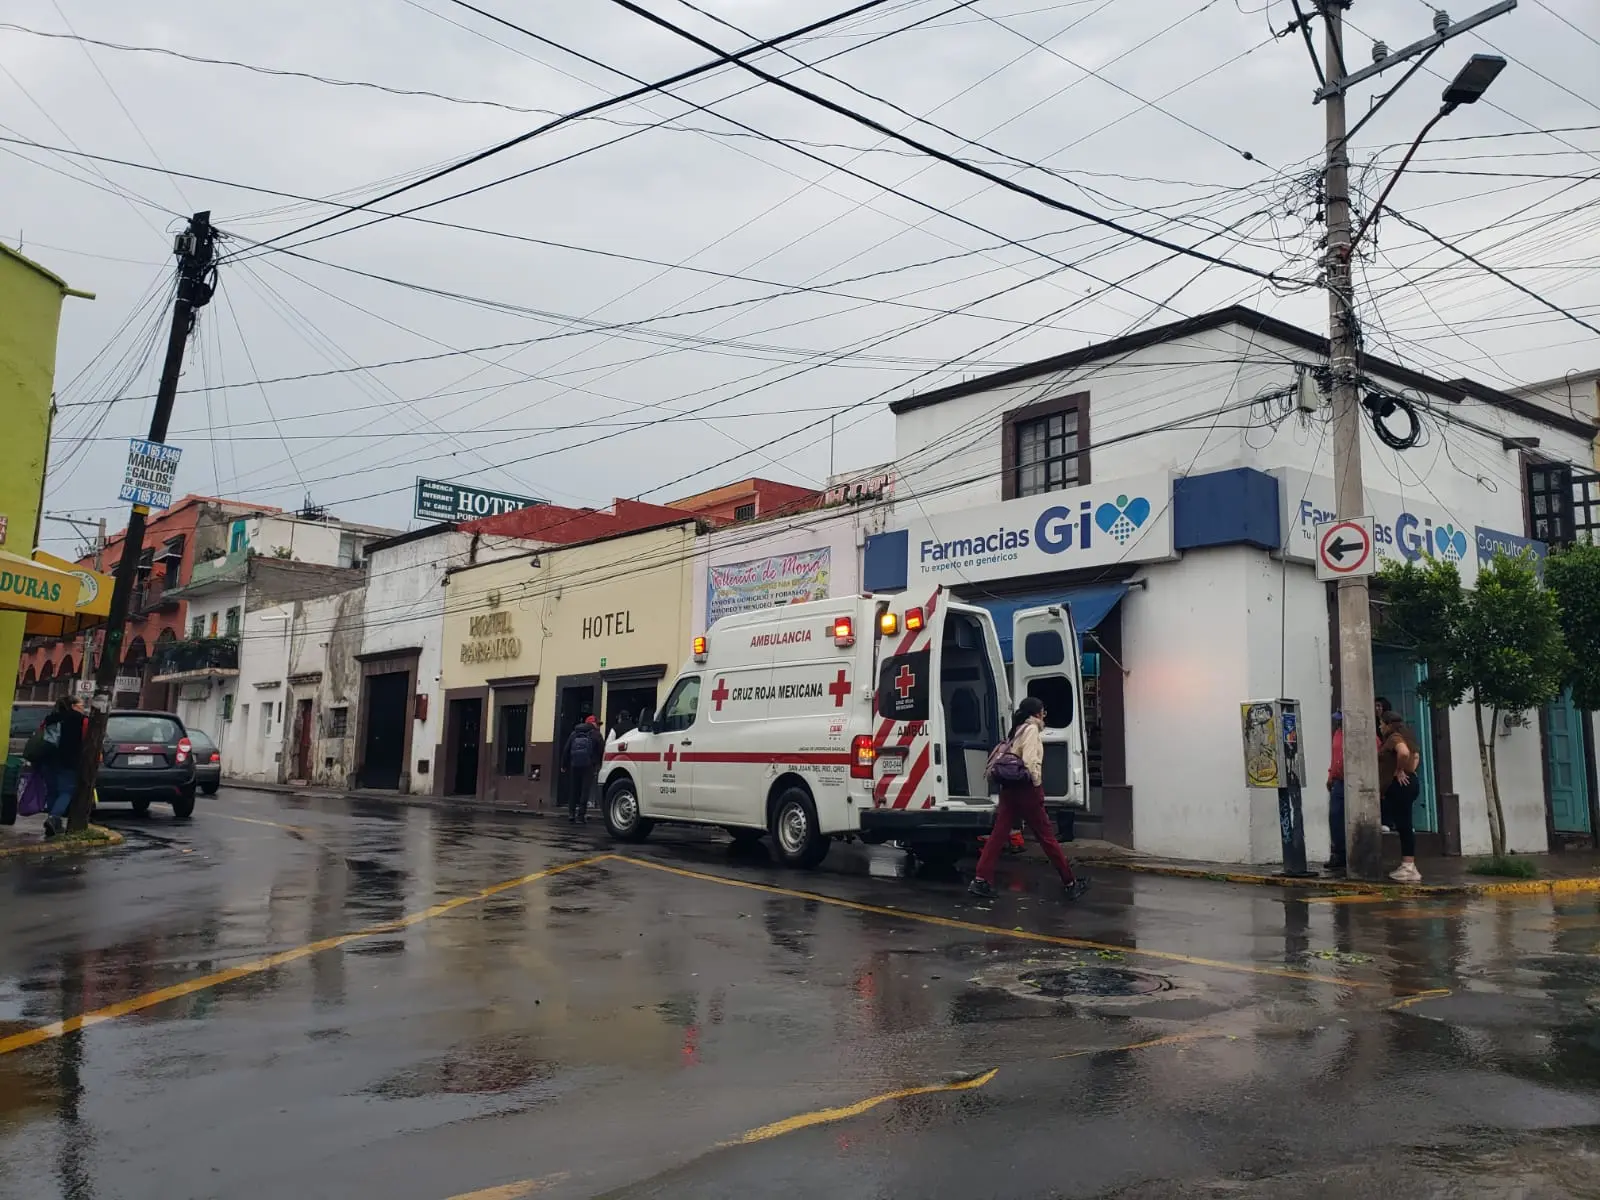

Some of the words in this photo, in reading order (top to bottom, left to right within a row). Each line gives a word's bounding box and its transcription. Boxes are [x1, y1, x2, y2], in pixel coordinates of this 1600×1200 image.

[130, 440, 145, 453] 427
[128, 453, 177, 475] MARIACHI
[125, 477, 134, 485] DE
[132, 467, 168, 485] GALLOS
[121, 485, 137, 499] 427
[424, 482, 453, 492] ALBERCA
[423, 491, 453, 502] INTERNET
[433, 503, 452, 511] CABLE
[457, 512, 482, 520] PORT
[921, 528, 1030, 563] Farmacias
[921, 565, 930, 573] Tu
[932, 562, 961, 572] experto
[976, 553, 1017, 566] genéricos
[0, 571, 61, 602] DURAS
[469, 611, 514, 636] HOTEL
[583, 610, 634, 639] HOTEL
[750, 630, 811, 647] AMBULANCIA
[732, 687, 753, 700] CRUZ
[755, 686, 776, 699] ROJA
[778, 683, 823, 699] MEXICANA
[897, 724, 929, 737] AMBUL
